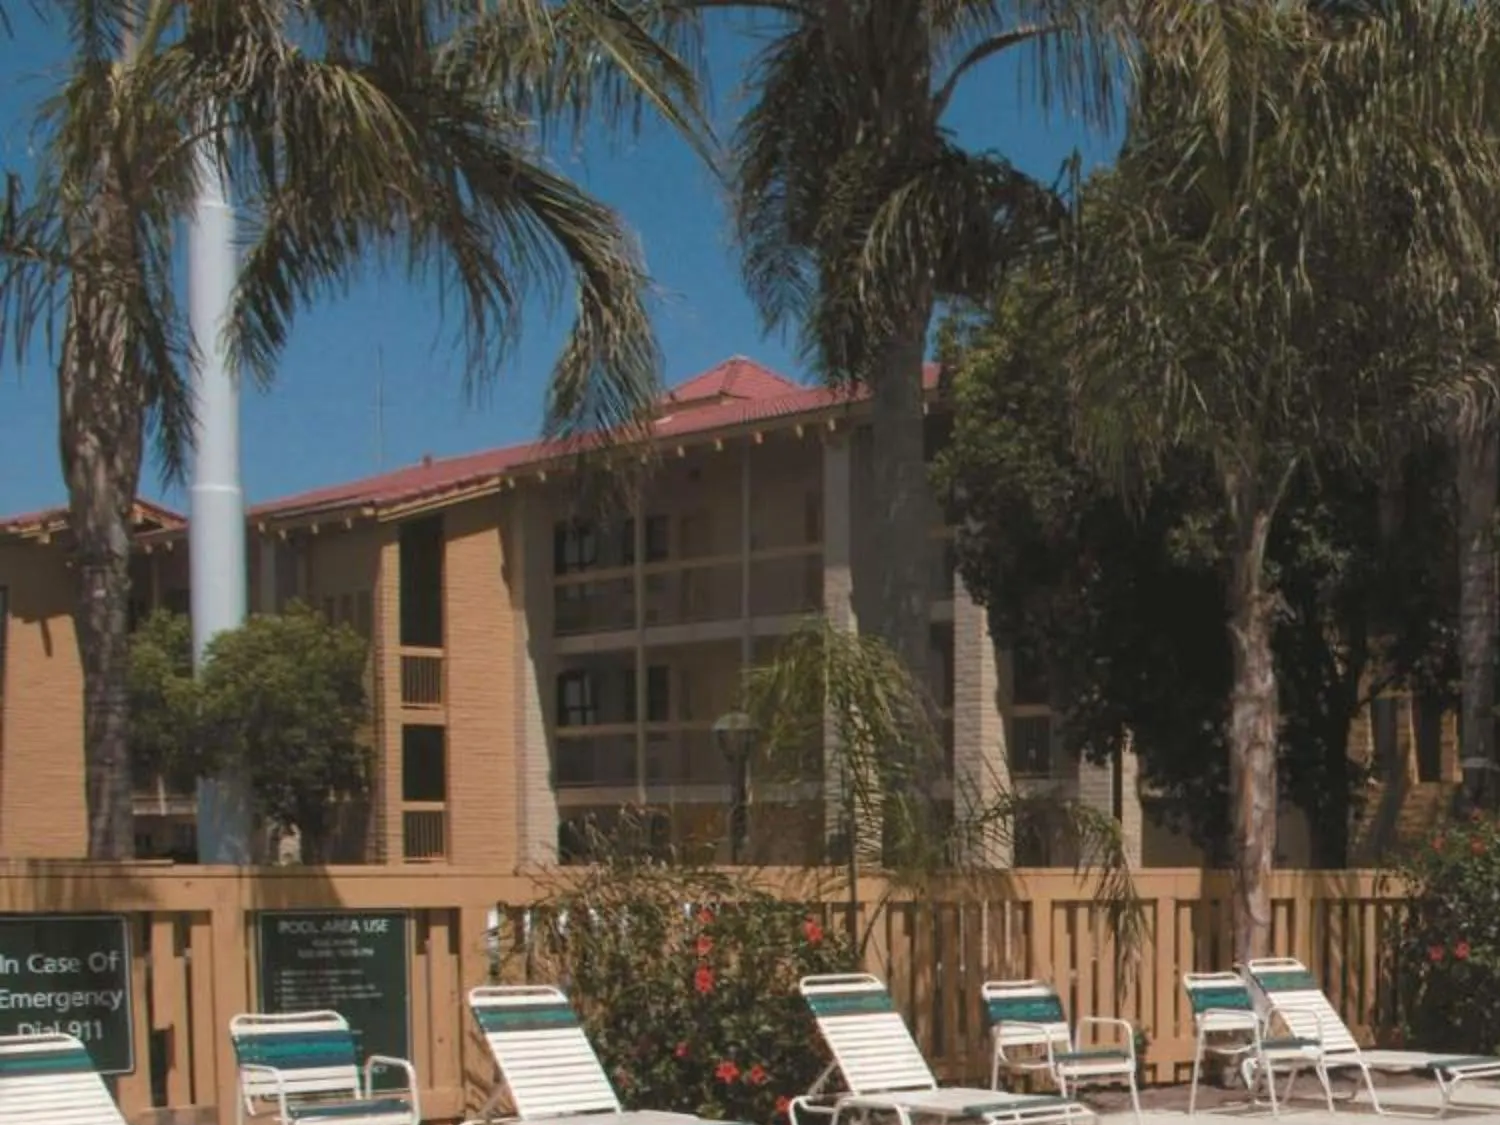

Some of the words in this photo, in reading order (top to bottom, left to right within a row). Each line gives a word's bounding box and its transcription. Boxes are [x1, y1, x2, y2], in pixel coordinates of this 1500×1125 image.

[278, 920, 319, 934] POOL
[363, 919, 390, 933] USE
[0, 953, 19, 974] In
[26, 952, 80, 974] Case
[88, 950, 119, 973] Of
[0, 988, 122, 1013] Emergency
[68, 1021, 103, 1041] 911
